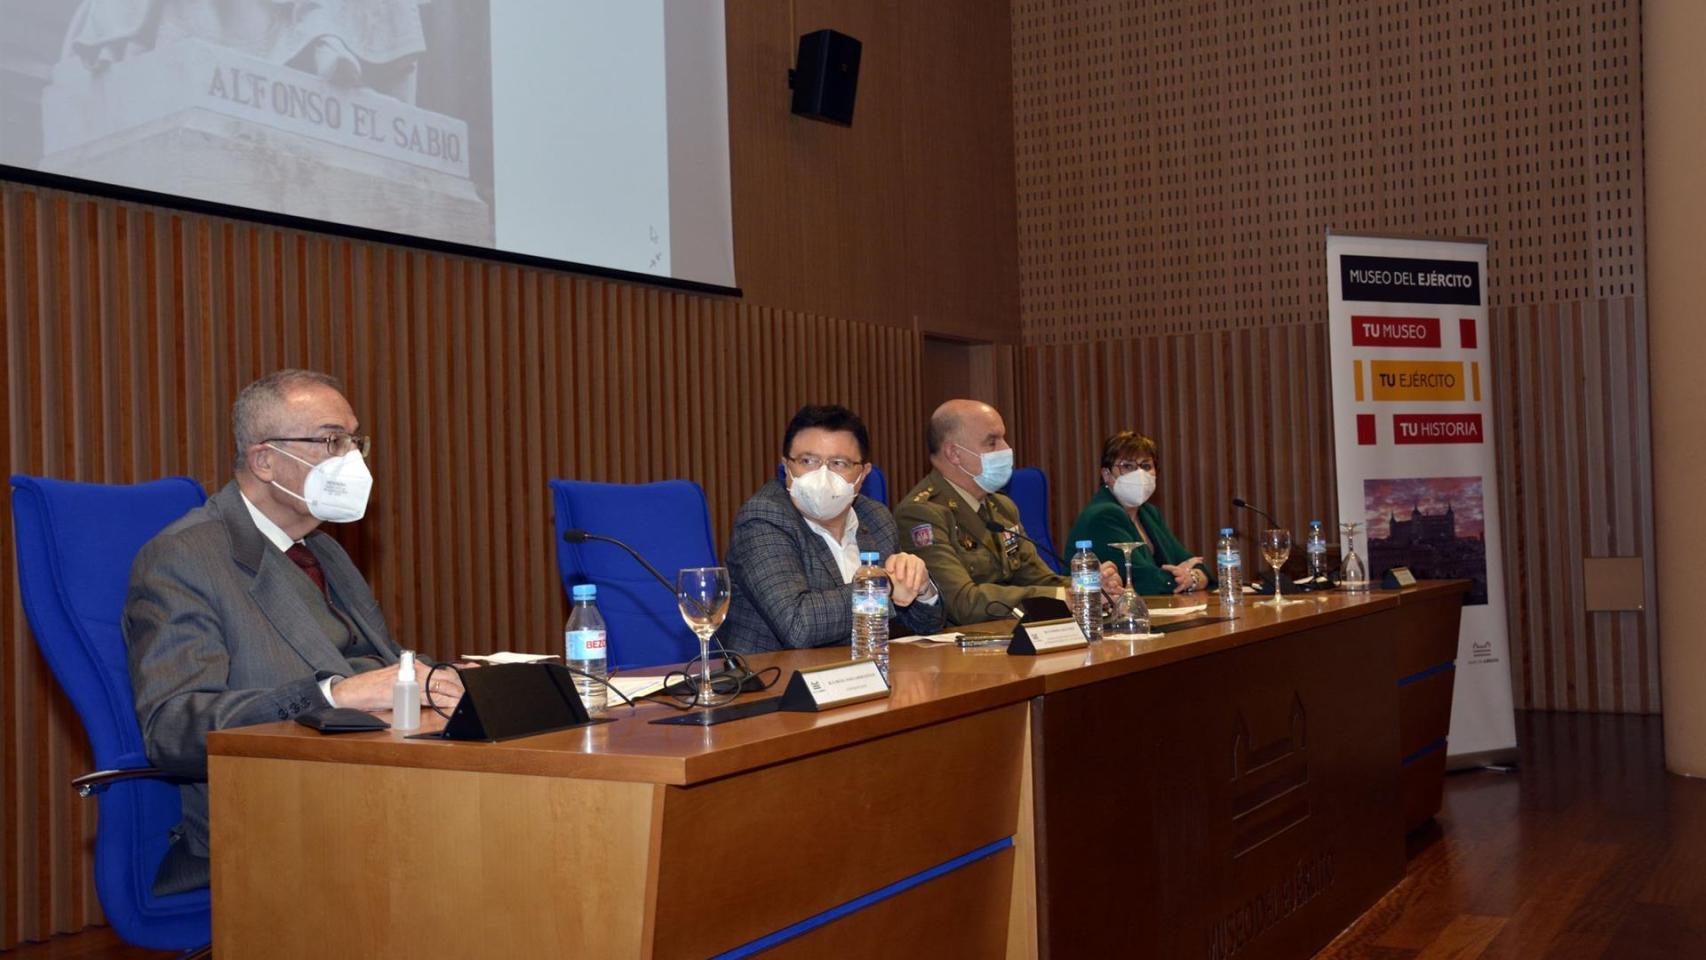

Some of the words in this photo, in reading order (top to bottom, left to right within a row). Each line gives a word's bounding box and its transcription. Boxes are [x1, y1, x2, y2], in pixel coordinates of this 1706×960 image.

[207, 65, 341, 130] ALFONSO
[351, 103, 385, 142] EL
[1349, 269, 1392, 284] MUSEO
[1394, 271, 1416, 286] DEL
[1417, 270, 1472, 288] EJÉRCITO
[1362, 323, 1380, 338] TU
[1382, 324, 1426, 339] MUSEO
[1379, 373, 1396, 387] TU
[1399, 371, 1455, 388] EJÉRCITO
[1400, 422, 1418, 437] TU
[1420, 422, 1478, 437] HISTORIA
